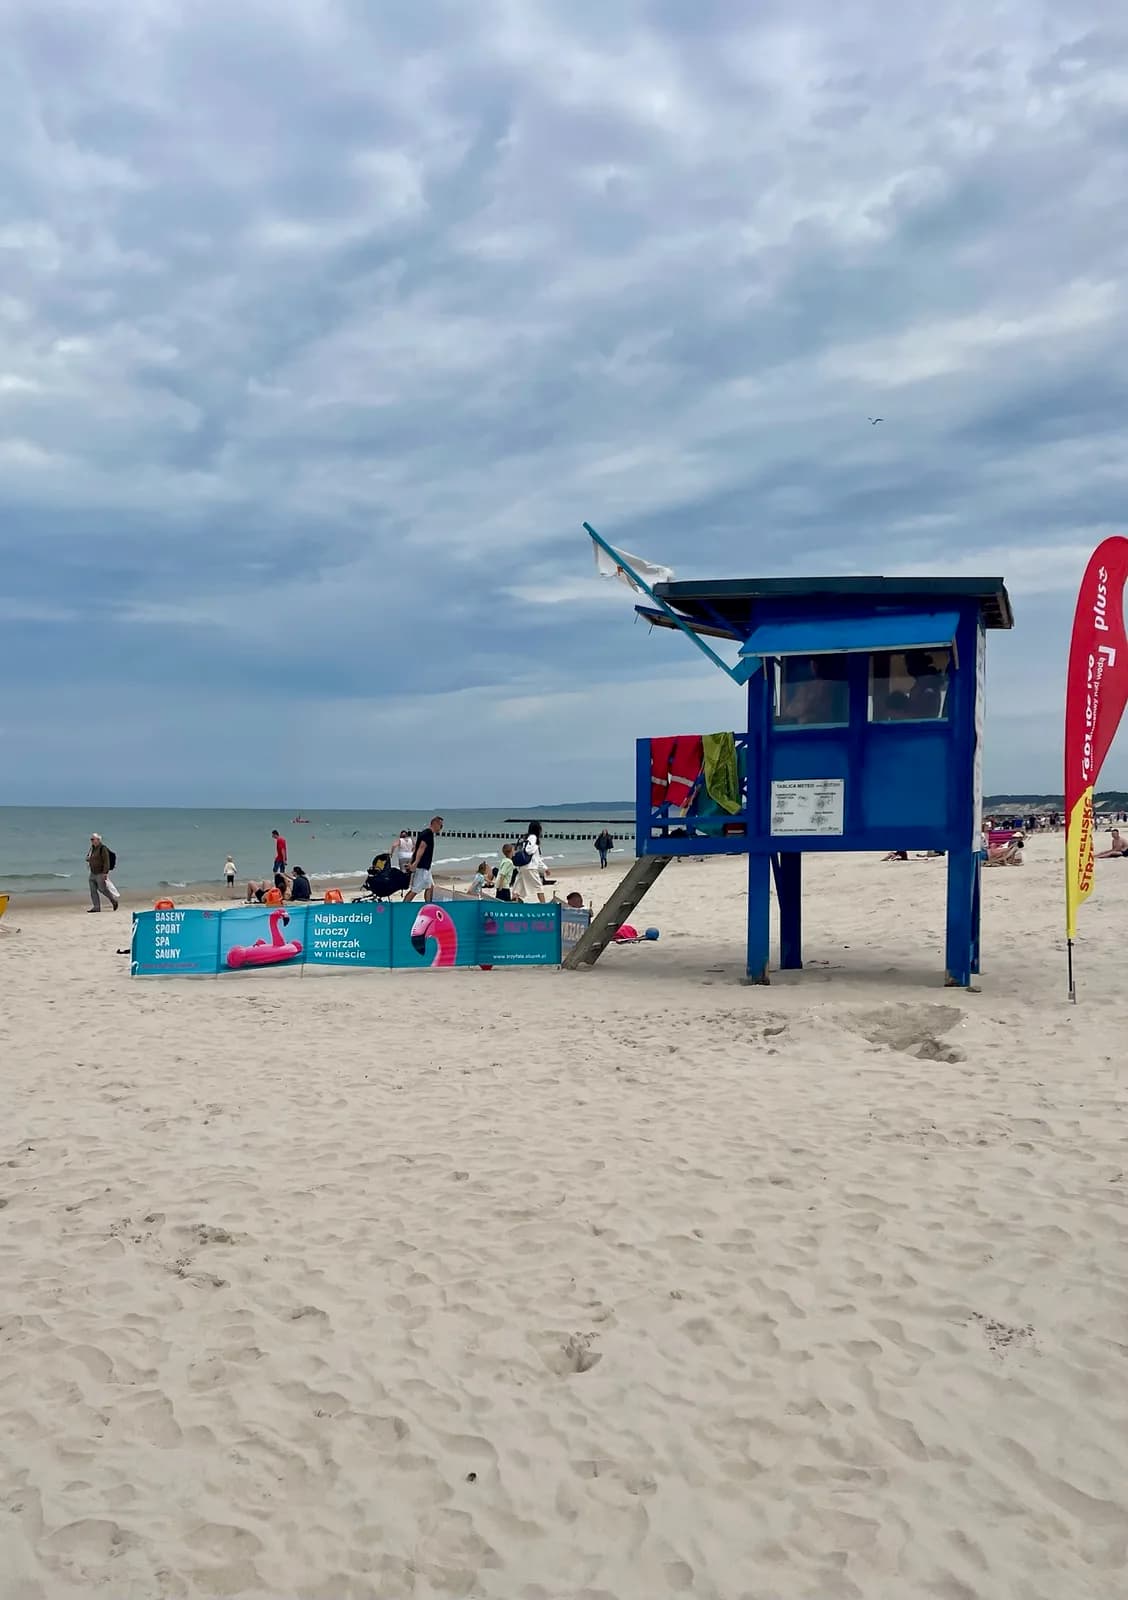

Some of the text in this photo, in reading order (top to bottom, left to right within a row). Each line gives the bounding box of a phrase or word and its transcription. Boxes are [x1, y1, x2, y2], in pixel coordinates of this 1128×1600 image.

[1095, 657, 1106, 680] wodą
[155, 912, 186, 922] BASENY
[314, 912, 373, 925] Najbardziej
[155, 924, 181, 934] SPORT
[314, 928, 349, 937] uroczy
[155, 936, 170, 947] SPA
[314, 938, 360, 948] zwierzak
[155, 949, 181, 959] SAUNY
[325, 949, 366, 959] mieście
